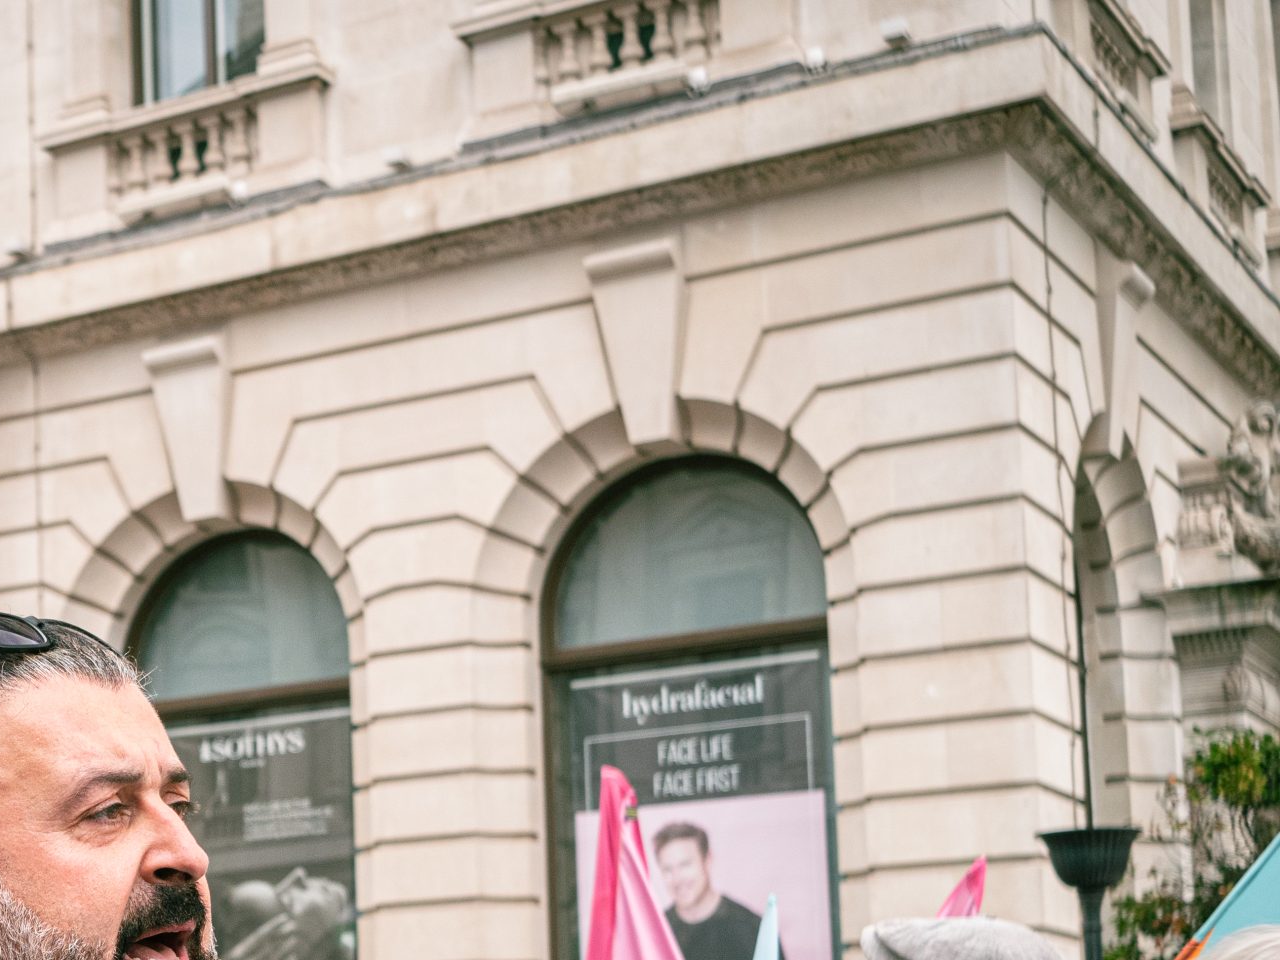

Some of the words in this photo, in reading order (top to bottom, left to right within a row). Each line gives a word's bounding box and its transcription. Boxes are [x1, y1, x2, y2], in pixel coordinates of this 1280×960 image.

[622, 673, 765, 726] hydrafacial
[656, 739, 700, 767] FACE
[701, 732, 735, 763] LIFE
[652, 767, 695, 799] FACE
[696, 763, 742, 794] FIRST
